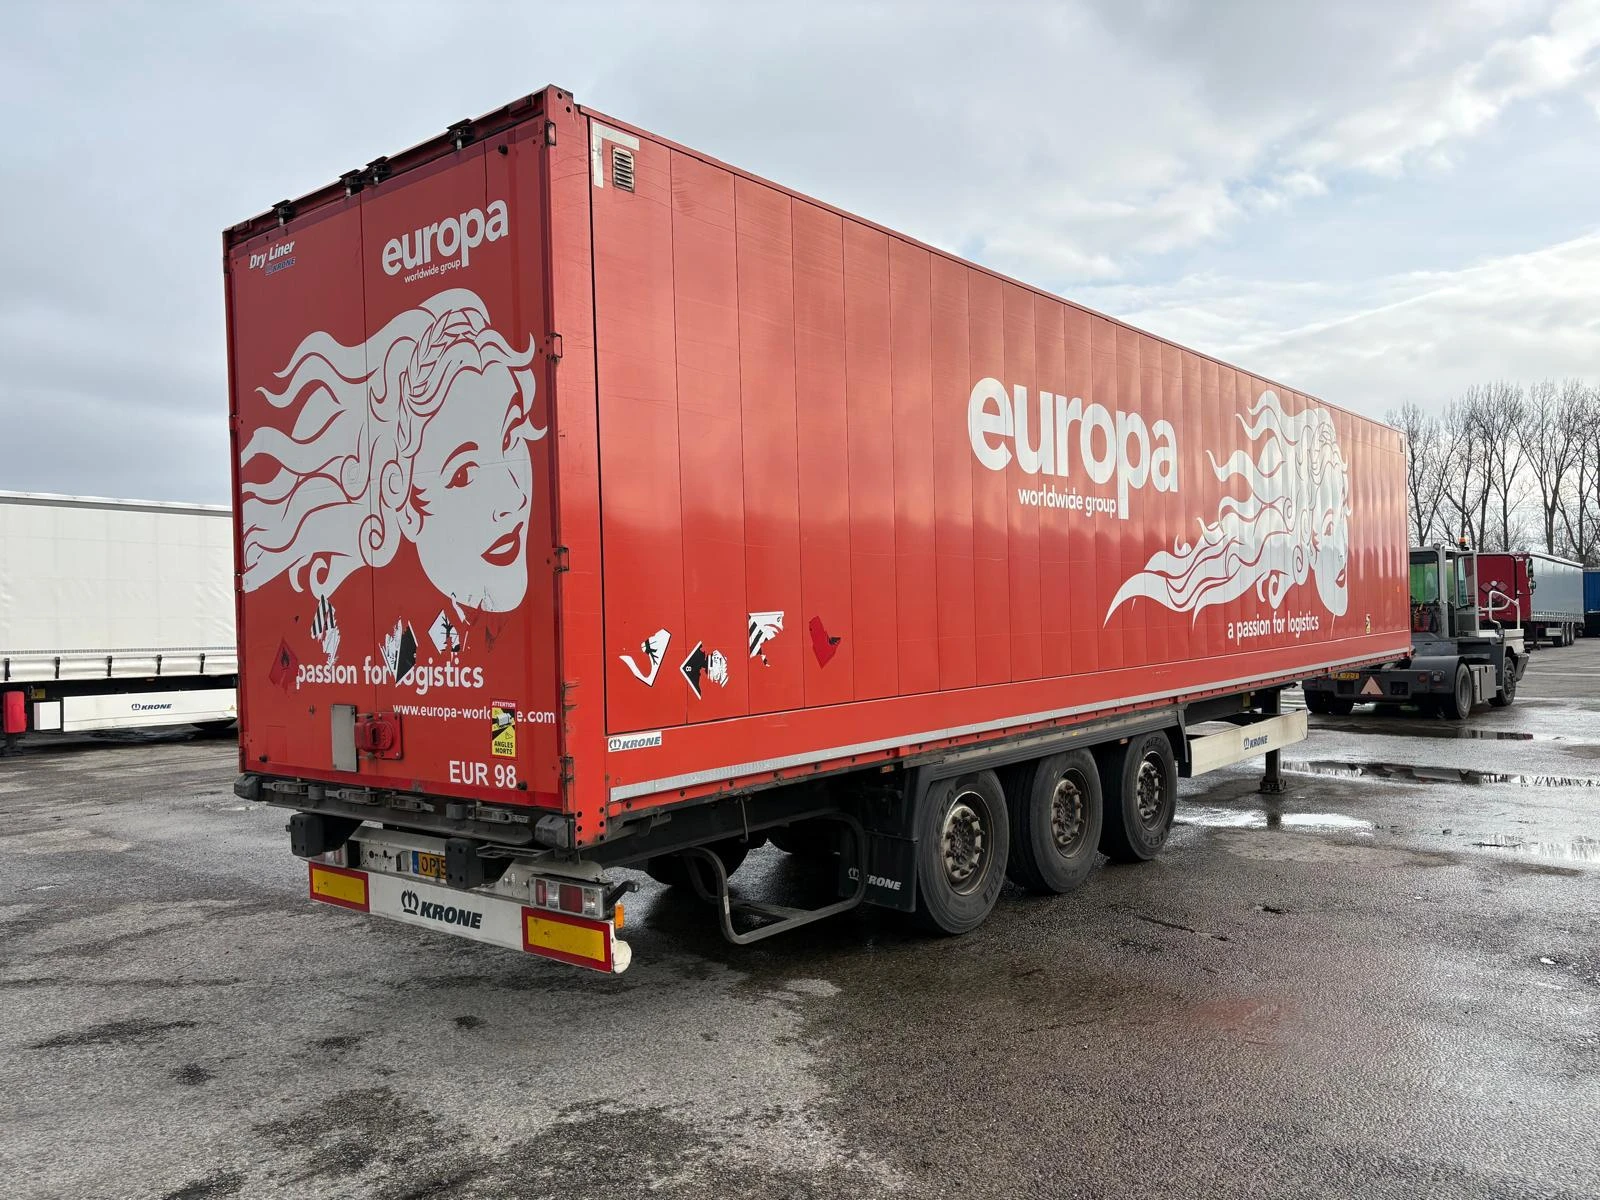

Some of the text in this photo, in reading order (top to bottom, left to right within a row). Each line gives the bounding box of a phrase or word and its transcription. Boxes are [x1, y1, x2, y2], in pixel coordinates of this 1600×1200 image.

[382, 200, 508, 275] europa
[249, 241, 295, 269] Dry Liner
[404, 260, 461, 283] worldwide group
[967, 377, 1178, 519] europa
[1018, 484, 1116, 518] worldwide group
[1228, 610, 1319, 646] a passion for logistics
[296, 655, 484, 695] passion for ogistics
[393, 704, 555, 724] www.europa-worle.com
[621, 736, 661, 749] KRONE
[449, 760, 517, 789] EUR 98
[867, 874, 902, 890] RONE
[420, 901, 483, 929] KRONE
